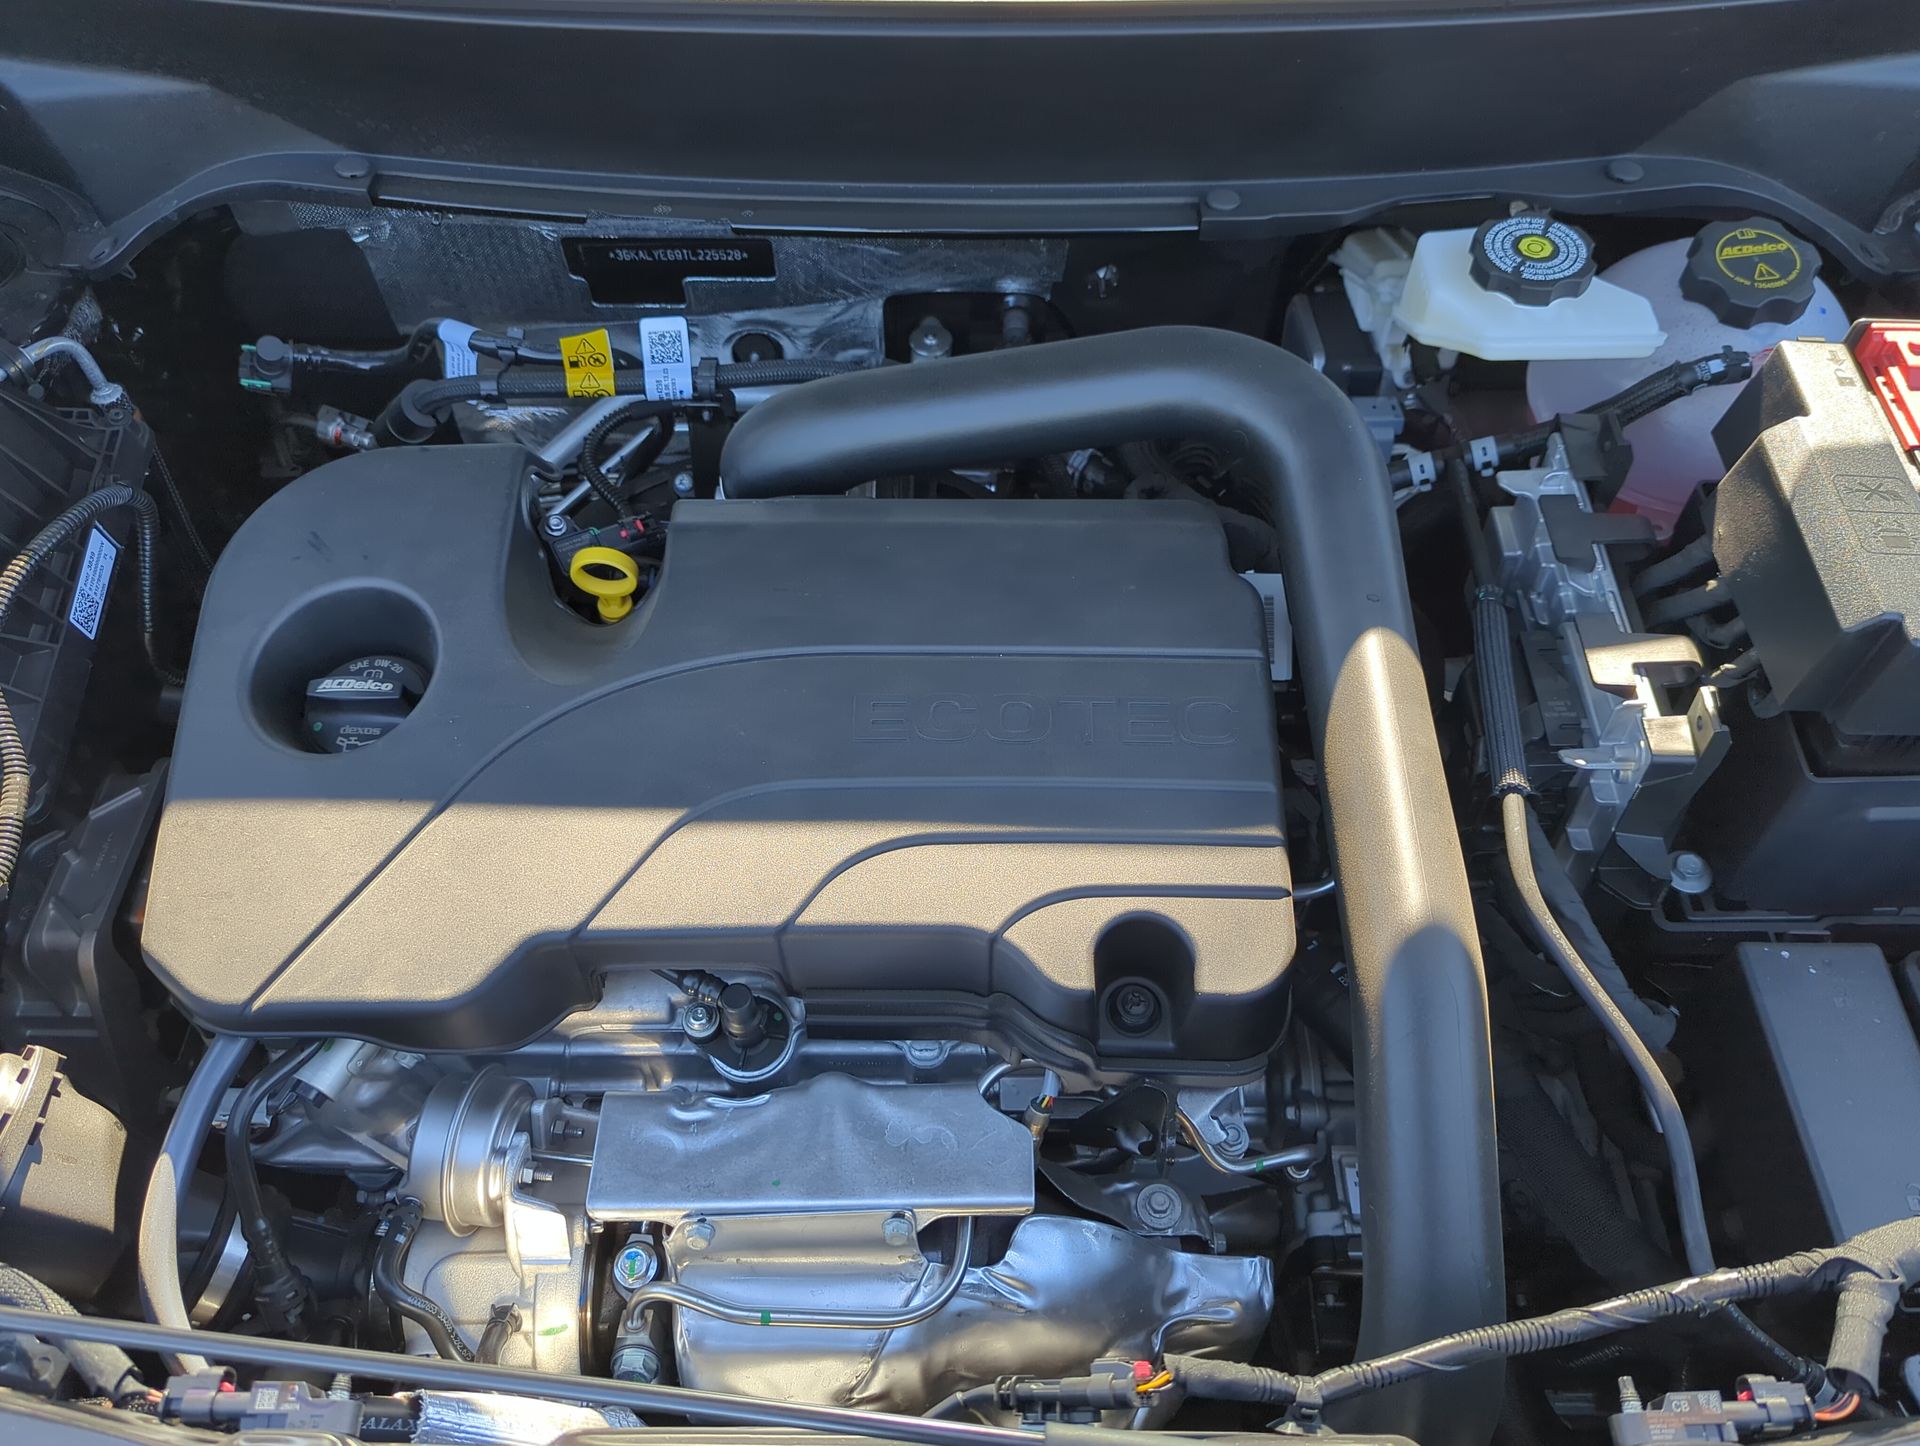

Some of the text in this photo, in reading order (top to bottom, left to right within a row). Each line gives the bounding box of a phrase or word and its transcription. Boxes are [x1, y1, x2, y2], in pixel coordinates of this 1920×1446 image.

[1721, 242, 1788, 256] ACDelco
[87, 551, 96, 572] 3839
[349, 658, 404, 674] SAE 0W-20
[318, 678, 394, 691] ACDelco
[851, 693, 1240, 745] ECOTEC
[340, 724, 382, 735] dexos
[1671, 1400, 1691, 1413] CB
